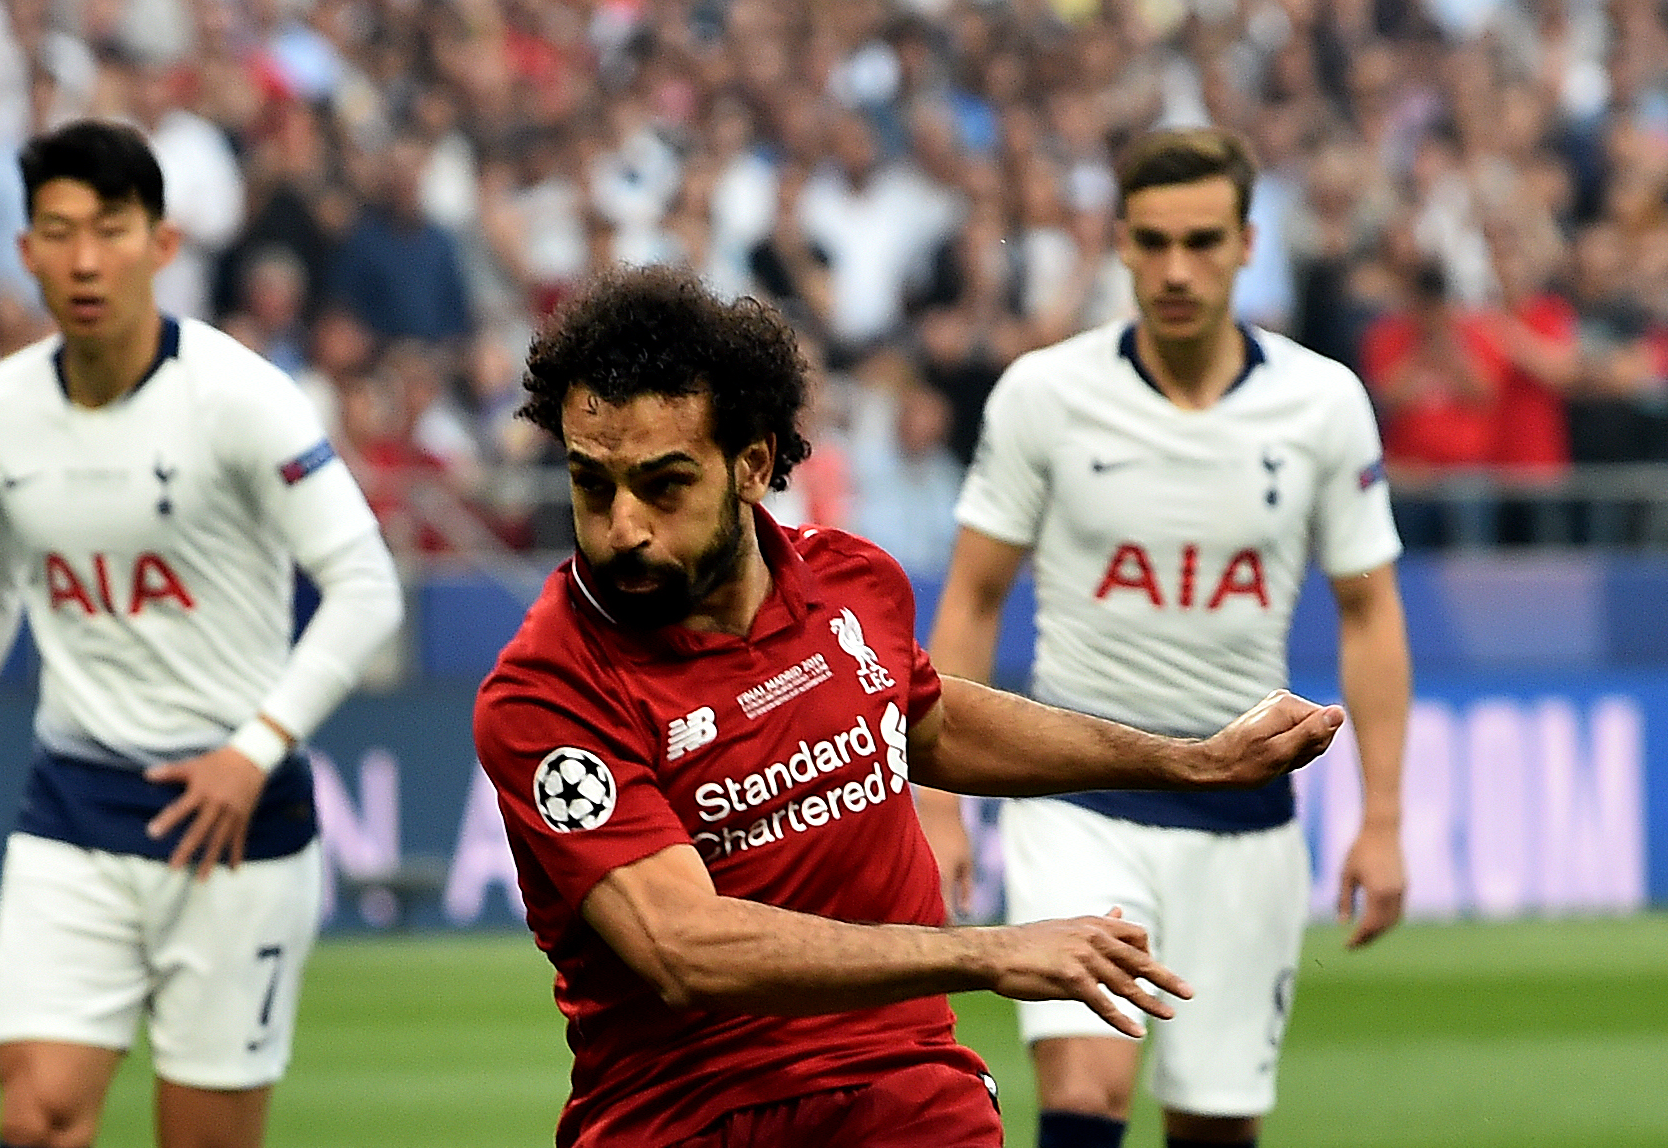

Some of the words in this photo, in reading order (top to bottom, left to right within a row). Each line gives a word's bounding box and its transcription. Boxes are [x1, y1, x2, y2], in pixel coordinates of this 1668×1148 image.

[44, 551, 195, 617] AIA
[1093, 541, 1271, 611] AIA
[695, 715, 877, 822] Standard
[693, 762, 886, 862] Chartered
[255, 944, 285, 1026] 7
